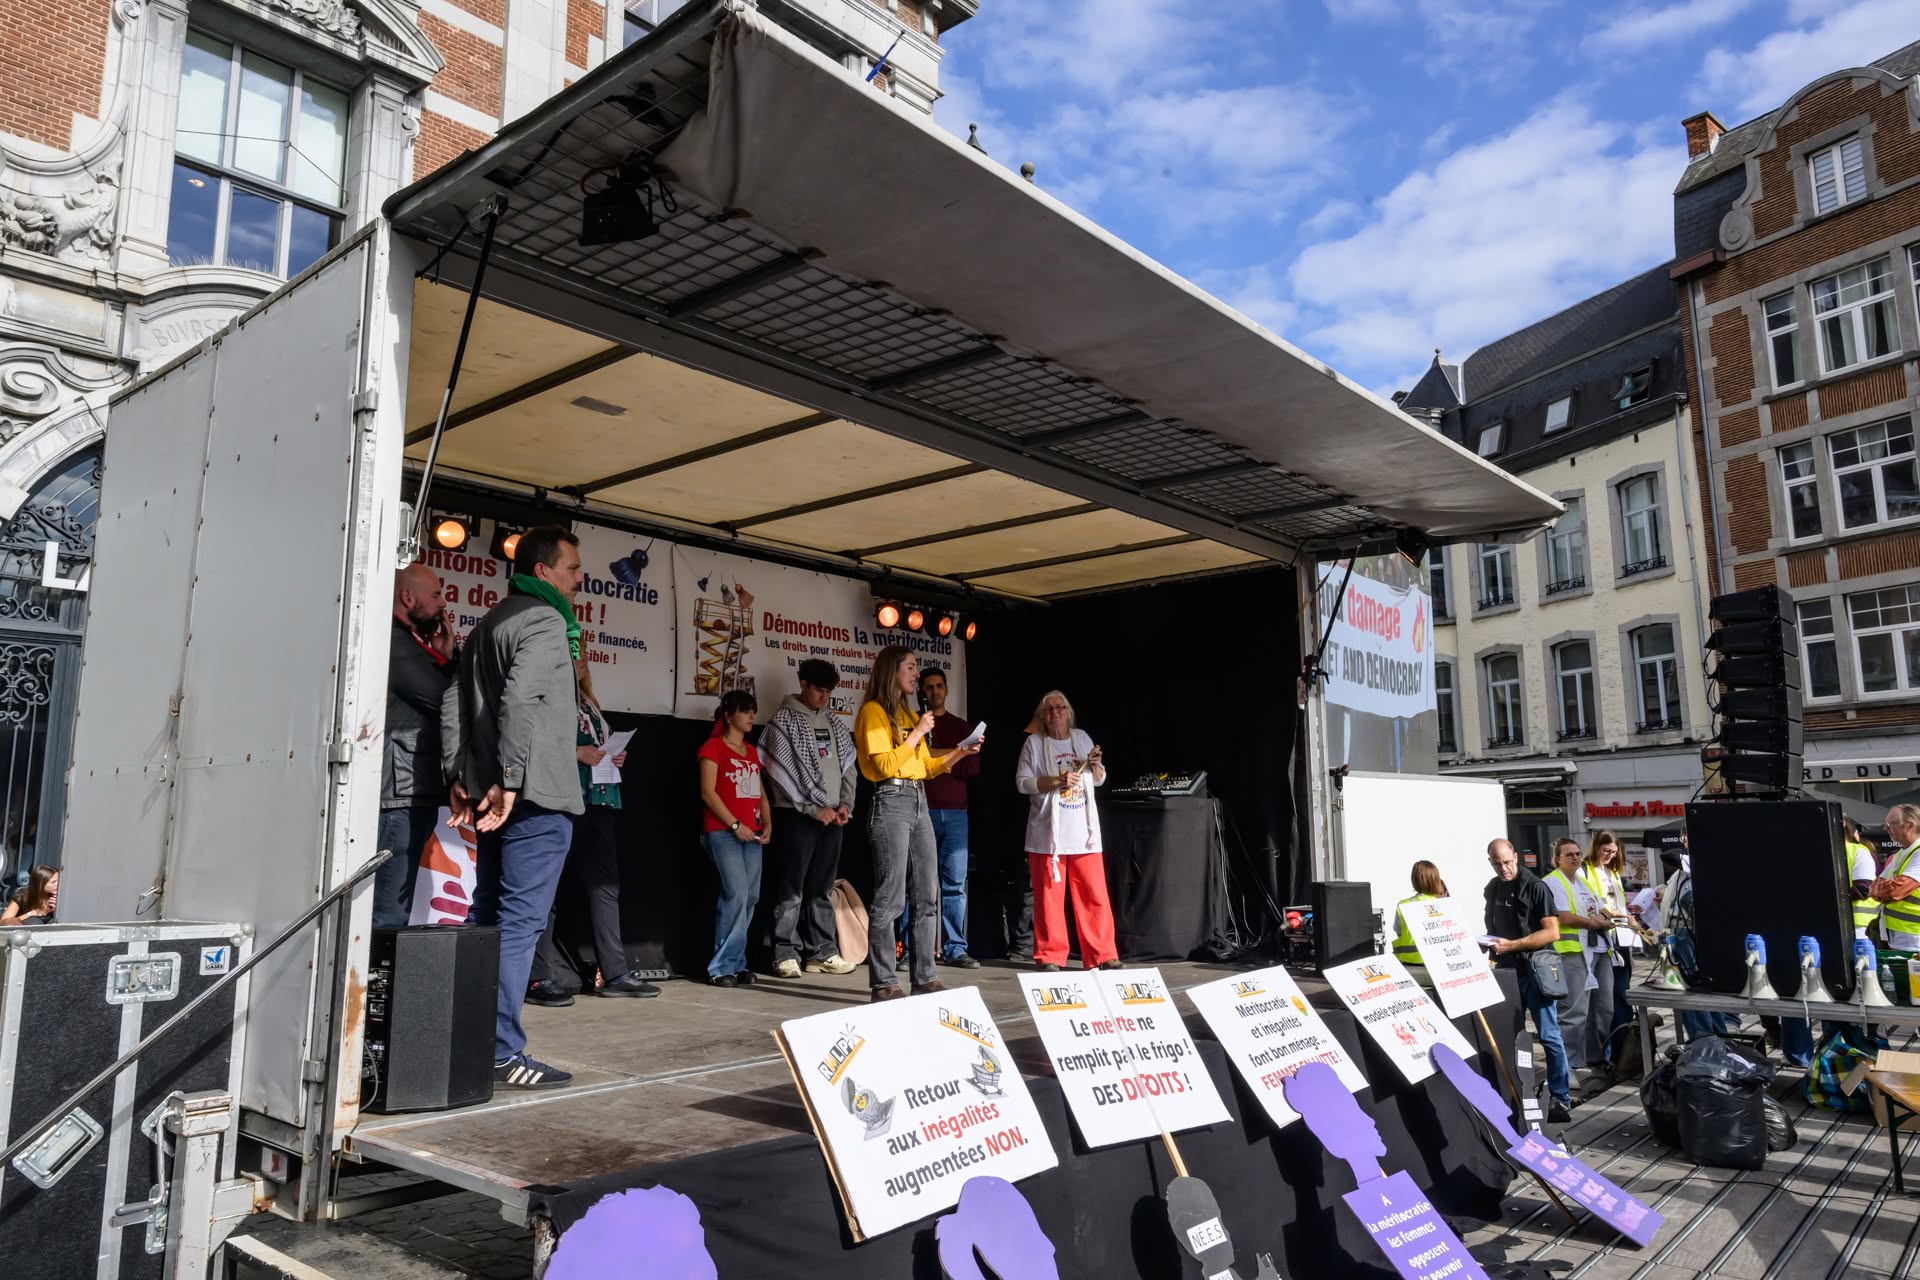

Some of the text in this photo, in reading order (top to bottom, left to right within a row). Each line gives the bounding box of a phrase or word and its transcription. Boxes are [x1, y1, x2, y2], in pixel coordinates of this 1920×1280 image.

[467, 584, 498, 608] de
[1347, 584, 1400, 641] damage
[763, 612, 849, 642] Démontons
[854, 626, 868, 644] la
[598, 632, 647, 652] financée,
[765, 637, 780, 648] Les
[782, 640, 808, 652] droits
[810, 645, 829, 655] pour
[832, 647, 862, 658] réduire
[787, 656, 796, 667] la
[1343, 646, 1365, 685] AND
[1366, 652, 1422, 696] DEMOCRACY
[1856, 765, 1891, 777] DU
[1585, 801, 1646, 817] Domino's
[1235, 996, 1288, 1018] Méritocratie
[1070, 1019, 1090, 1037] Le
[1137, 1016, 1155, 1031] ne
[1251, 1016, 1302, 1038] et inégalités
[1057, 1048, 1111, 1074] remplit
[1136, 1043, 1151, 1060] le
[1151, 1041, 1184, 1063] frigo
[1249, 1050, 1273, 1068] font
[1269, 1045, 1290, 1059] bon
[1288, 1036, 1320, 1052] ménage
[904, 1078, 961, 1109] Retour
[1092, 1083, 1123, 1106] DES
[887, 1101, 1000, 1155] aux inégalités
[884, 1126, 1029, 1197] augmentées NON.
[1379, 1193, 1392, 1206] À
[1367, 1201, 1431, 1234] la méritocratie
[1386, 1222, 1436, 1248] les femmes
[1408, 1241, 1449, 1269] opposent
[1429, 1258, 1463, 1280] pouvoir
